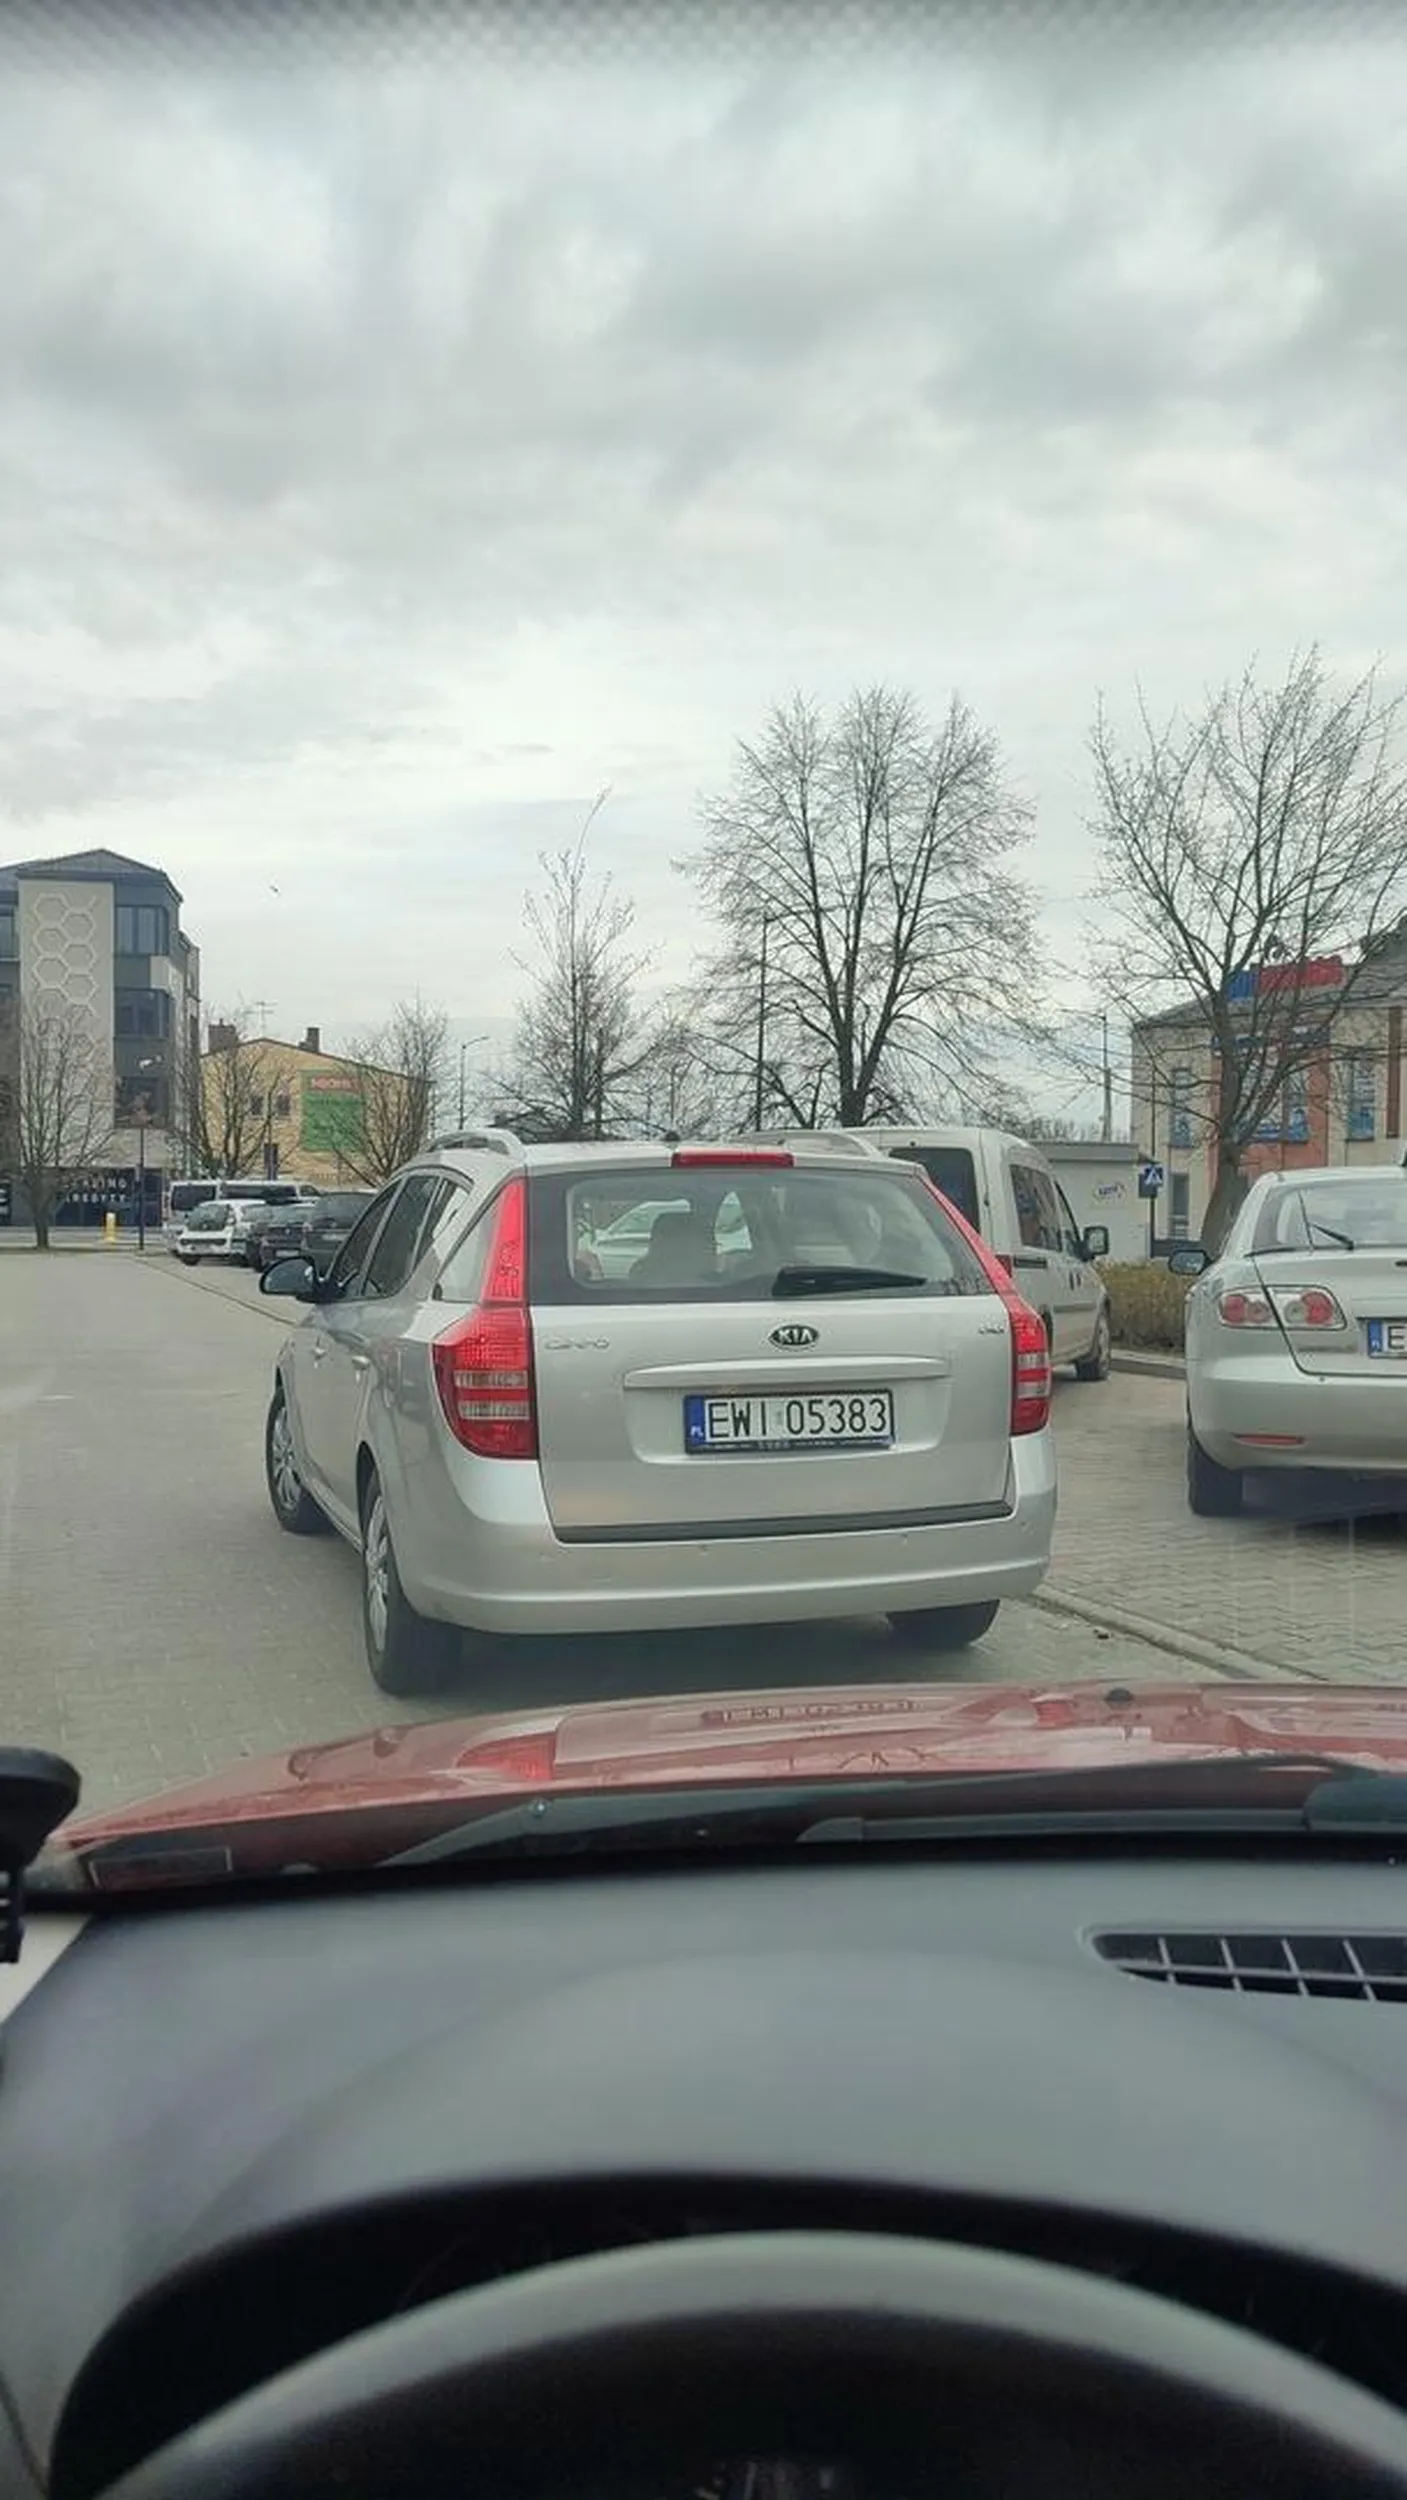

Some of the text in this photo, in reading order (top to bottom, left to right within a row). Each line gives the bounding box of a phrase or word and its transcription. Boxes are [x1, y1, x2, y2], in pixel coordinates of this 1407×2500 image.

[777, 1328, 813, 1343] KIA
[1388, 1326, 1405, 1349] E
[708, 1398, 887, 1438] EWI 05383
